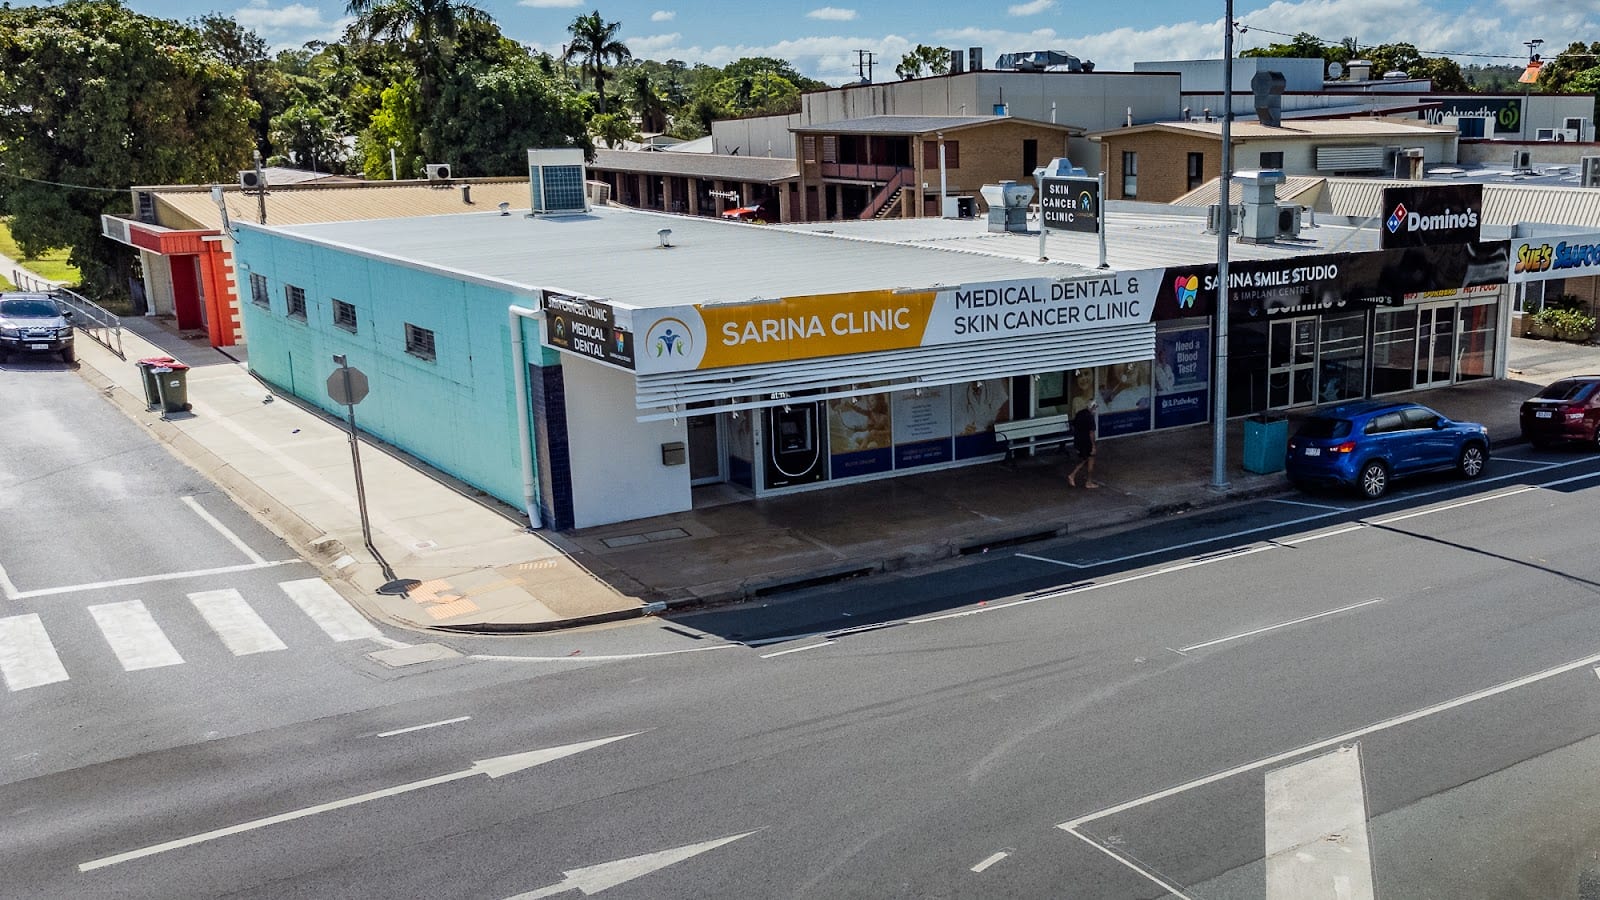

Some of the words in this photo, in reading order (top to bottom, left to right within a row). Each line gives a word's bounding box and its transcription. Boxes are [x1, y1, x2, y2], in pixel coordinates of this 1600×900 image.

[1050, 184, 1069, 195] SKIN
[1043, 197, 1077, 209] CANCER
[1045, 211, 1074, 222] CLINIC
[1407, 208, 1478, 232] Domino's
[1204, 272, 1251, 290] SAINA
[1254, 270, 1290, 287] SMILE
[1292, 264, 1338, 282] STUDIO
[955, 285, 1046, 309] MEDICAL,
[1051, 278, 1122, 300] DENTAL
[1127, 277, 1139, 294] &
[1241, 288, 1275, 299] IMPLANT
[1278, 285, 1310, 296] CENTRE
[587, 305, 607, 322] CLINIC
[954, 313, 998, 335] SKIN
[1003, 306, 1080, 330] CANCER
[1084, 300, 1140, 322] CLINIC
[571, 321, 606, 342] MEDICAL
[722, 315, 825, 346] SARINA
[831, 307, 910, 336] CLINIC
[573, 338, 605, 358] DENTAL
[1175, 340, 1194, 352] Need
[1177, 351, 1198, 363] Blood
[1178, 363, 1197, 375] Test?
